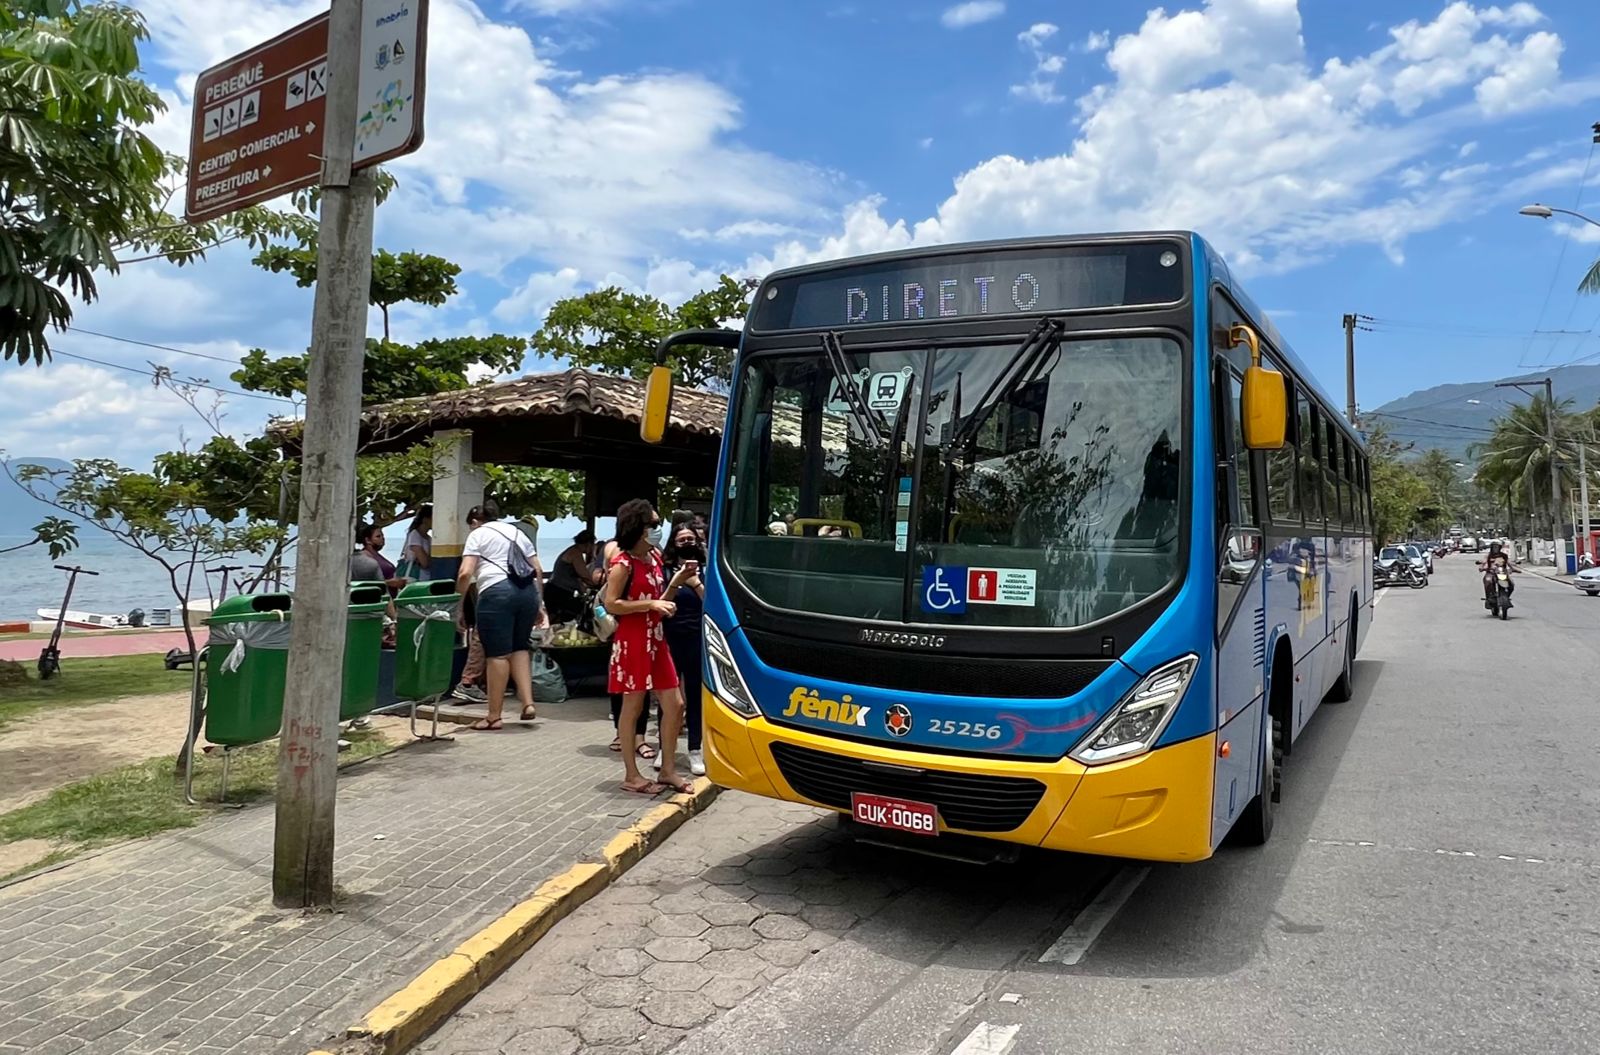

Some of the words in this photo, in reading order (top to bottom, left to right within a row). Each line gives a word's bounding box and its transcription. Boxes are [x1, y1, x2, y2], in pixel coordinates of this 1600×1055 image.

[205, 61, 264, 103] PEREQUÊ
[198, 152, 237, 174] CENTRO
[239, 126, 302, 158] COMERCIAL
[195, 168, 260, 202] PREFEITURA
[846, 273, 1039, 324] DIRETO
[861, 628, 945, 648] Marcopolo
[782, 686, 871, 728] fênix
[927, 719, 1002, 740] 25256
